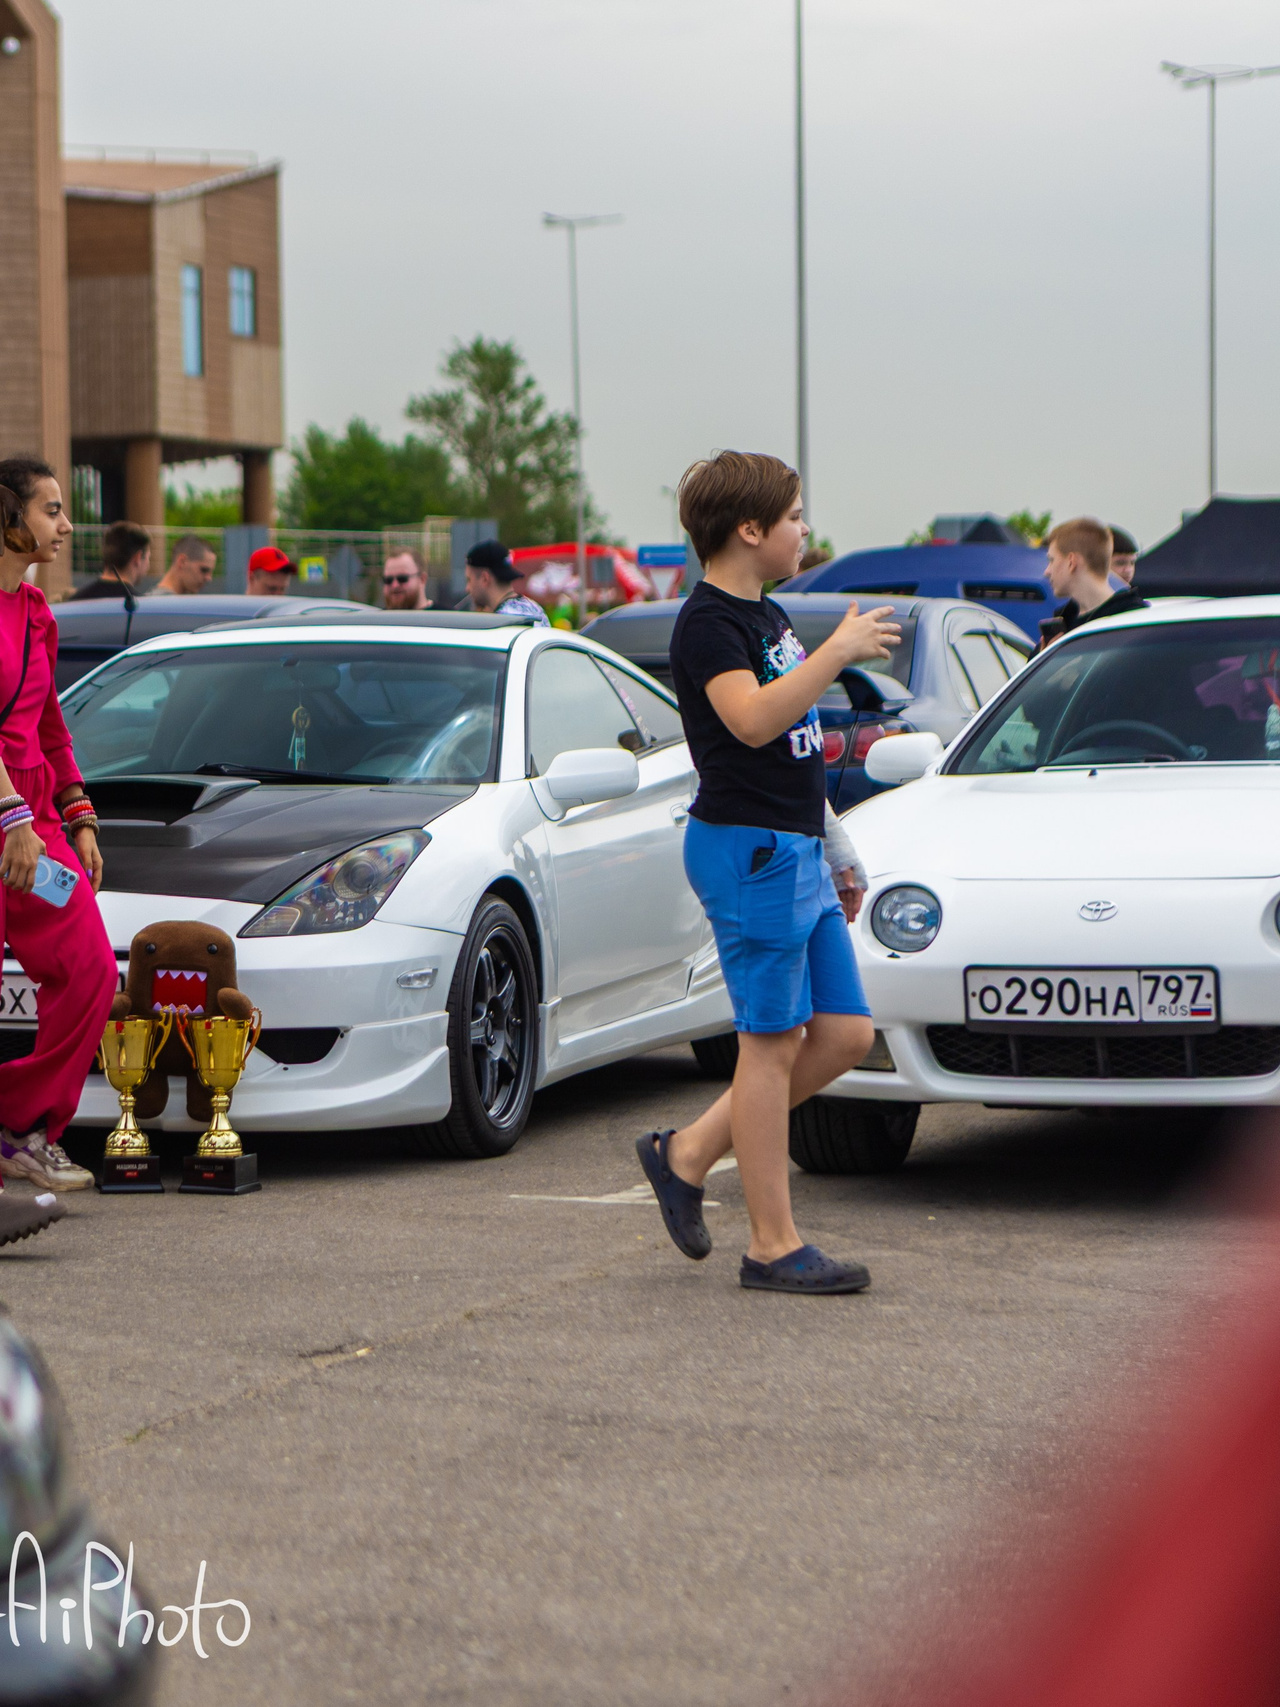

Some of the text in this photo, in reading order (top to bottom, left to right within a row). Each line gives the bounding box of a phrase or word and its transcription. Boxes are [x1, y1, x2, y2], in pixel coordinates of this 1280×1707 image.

[769, 628, 806, 671] GAME
[790, 720, 824, 758] OV
[1142, 975, 1204, 1005] 797
[1157, 1005, 1189, 1016] RUS
